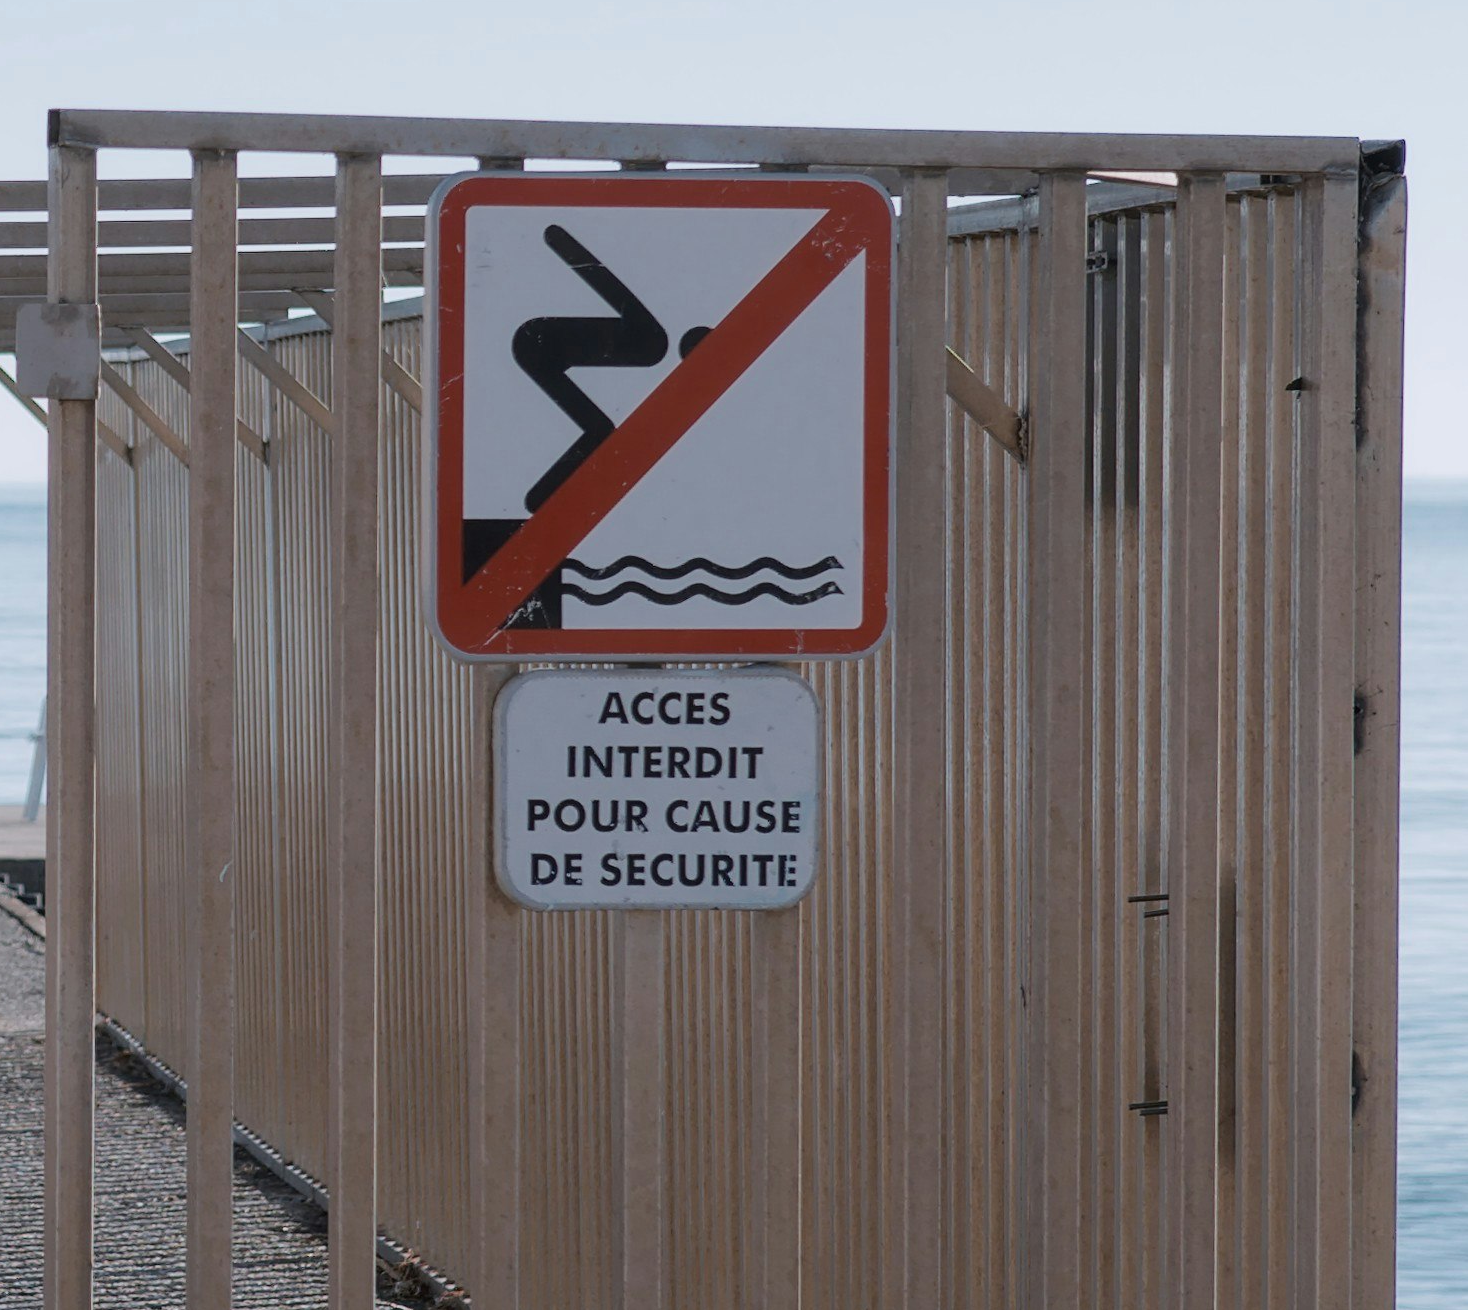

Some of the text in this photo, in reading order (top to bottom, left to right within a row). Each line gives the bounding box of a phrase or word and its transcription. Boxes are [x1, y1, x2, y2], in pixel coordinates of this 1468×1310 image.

[599, 692, 731, 726] ACCES
[567, 746, 764, 780] INTERDIT
[527, 799, 801, 833] POUR CAUSE
[530, 852, 797, 887] DE SECURITE
